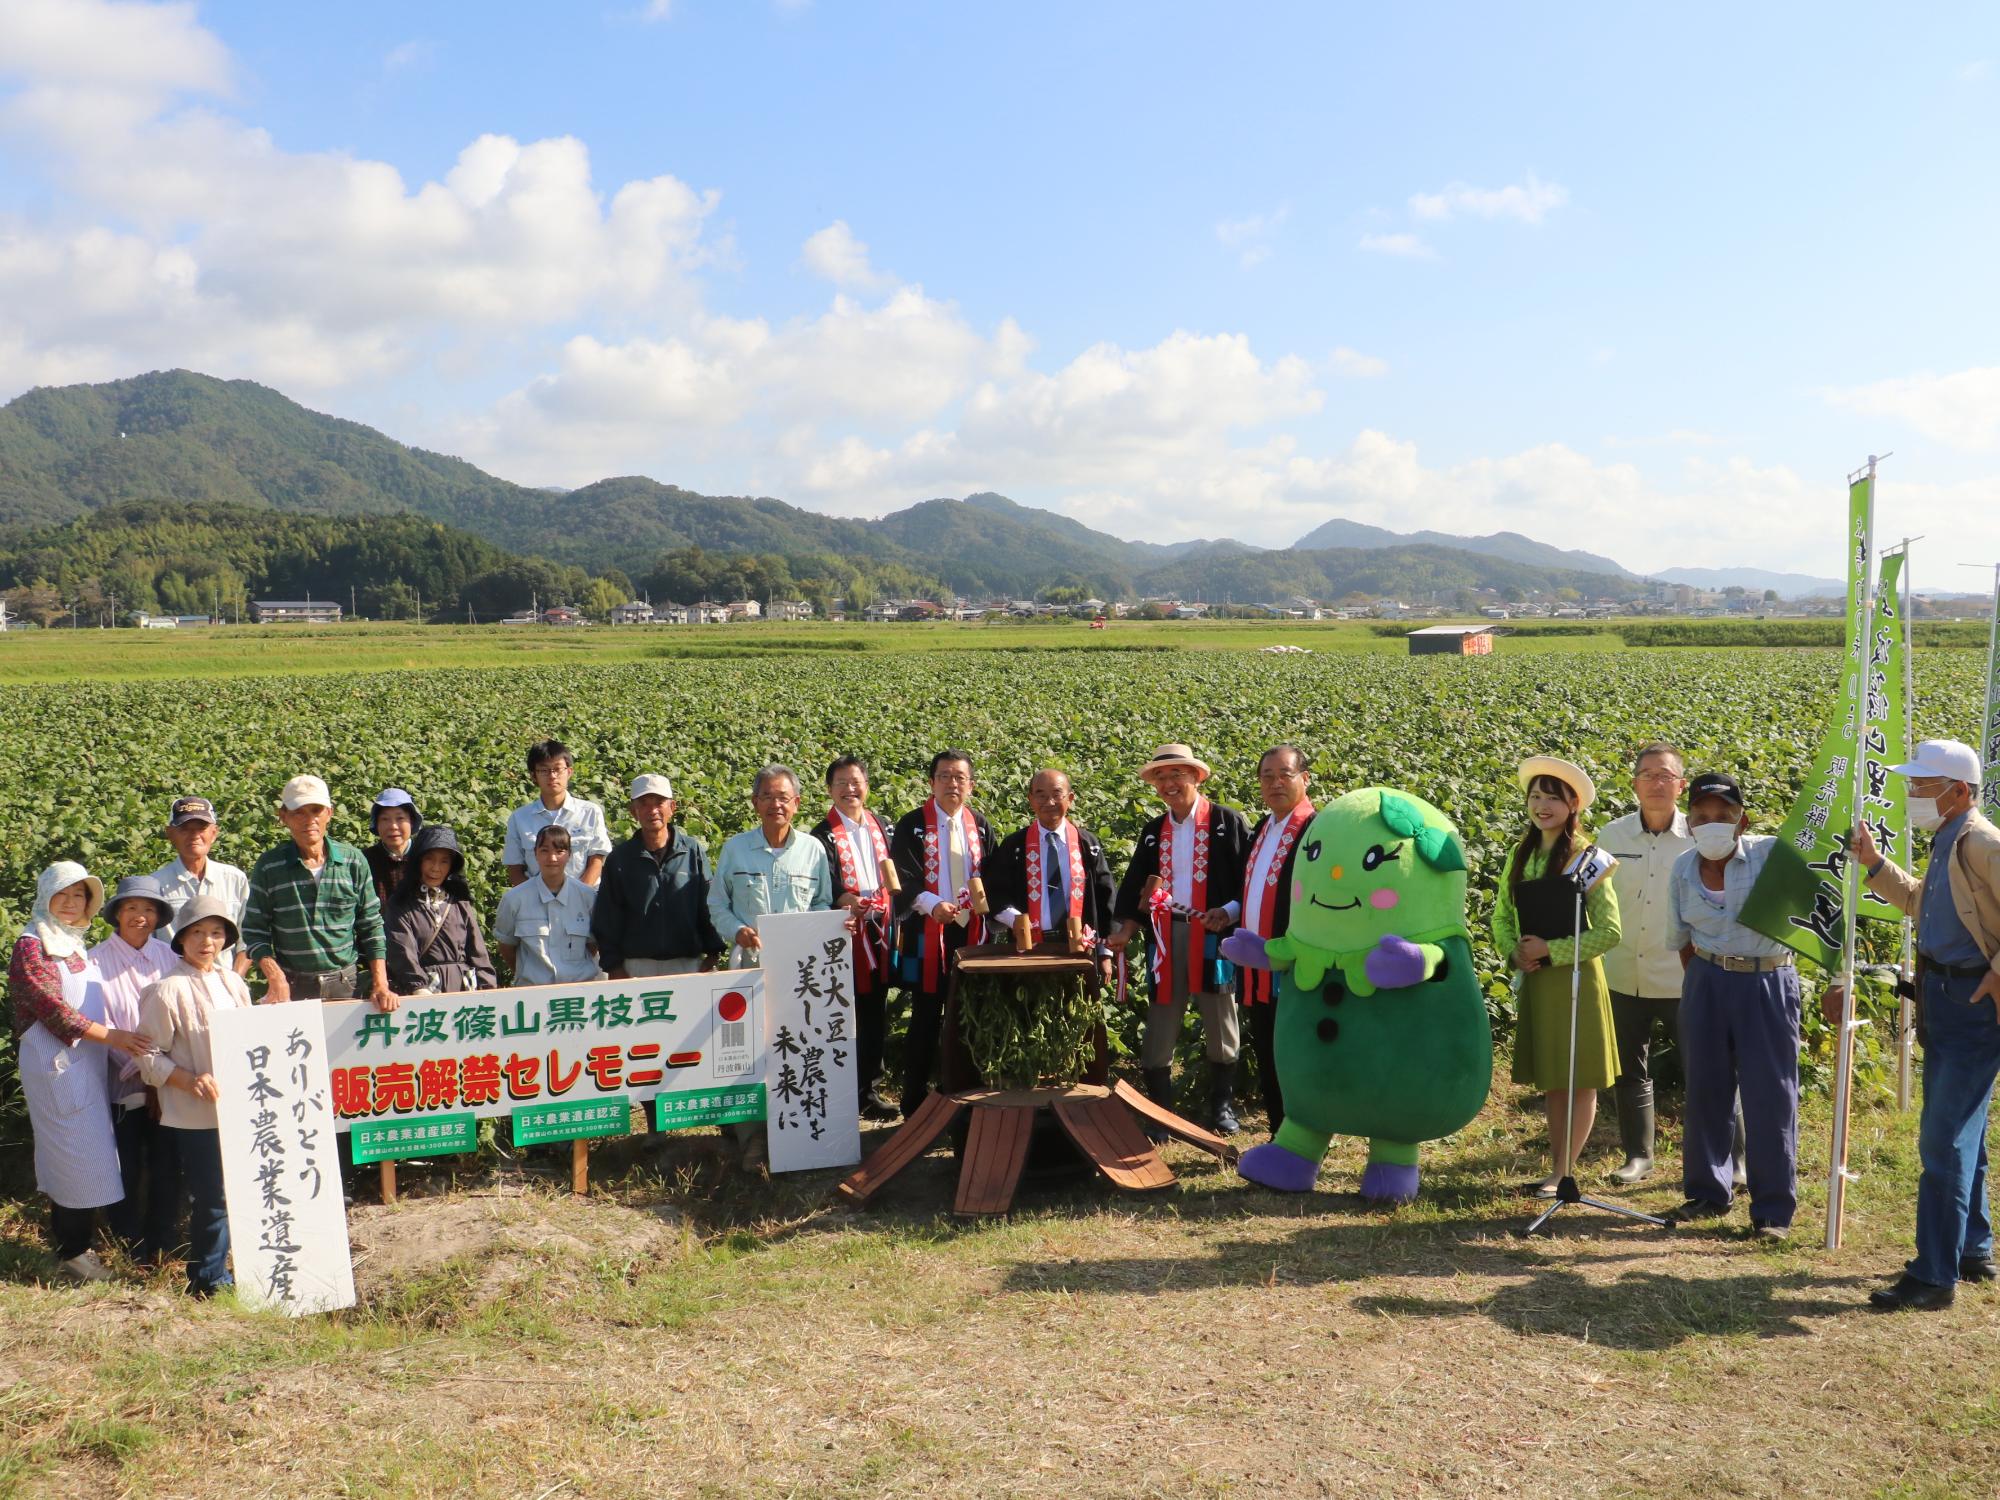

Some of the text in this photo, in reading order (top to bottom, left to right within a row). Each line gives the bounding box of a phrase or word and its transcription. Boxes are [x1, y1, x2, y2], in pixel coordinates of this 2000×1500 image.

[355, 990, 679, 1048] 丹波篠山黒枝豆
[821, 937, 850, 1067] 黒大豆と
[331, 1043, 702, 1119] 販売解禁セレモニー
[772, 1025, 803, 1130] 未来に
[794, 955, 828, 1141] 美しい農村を
[285, 1027, 325, 1200] ありがとう
[360, 1123, 466, 1144] 日本農業遺産認定
[521, 1106, 621, 1127] 日本農業遺産認定
[663, 1093, 758, 1113] 日本農業遺産認定
[245, 1045, 302, 1301] 日本農業遺産
